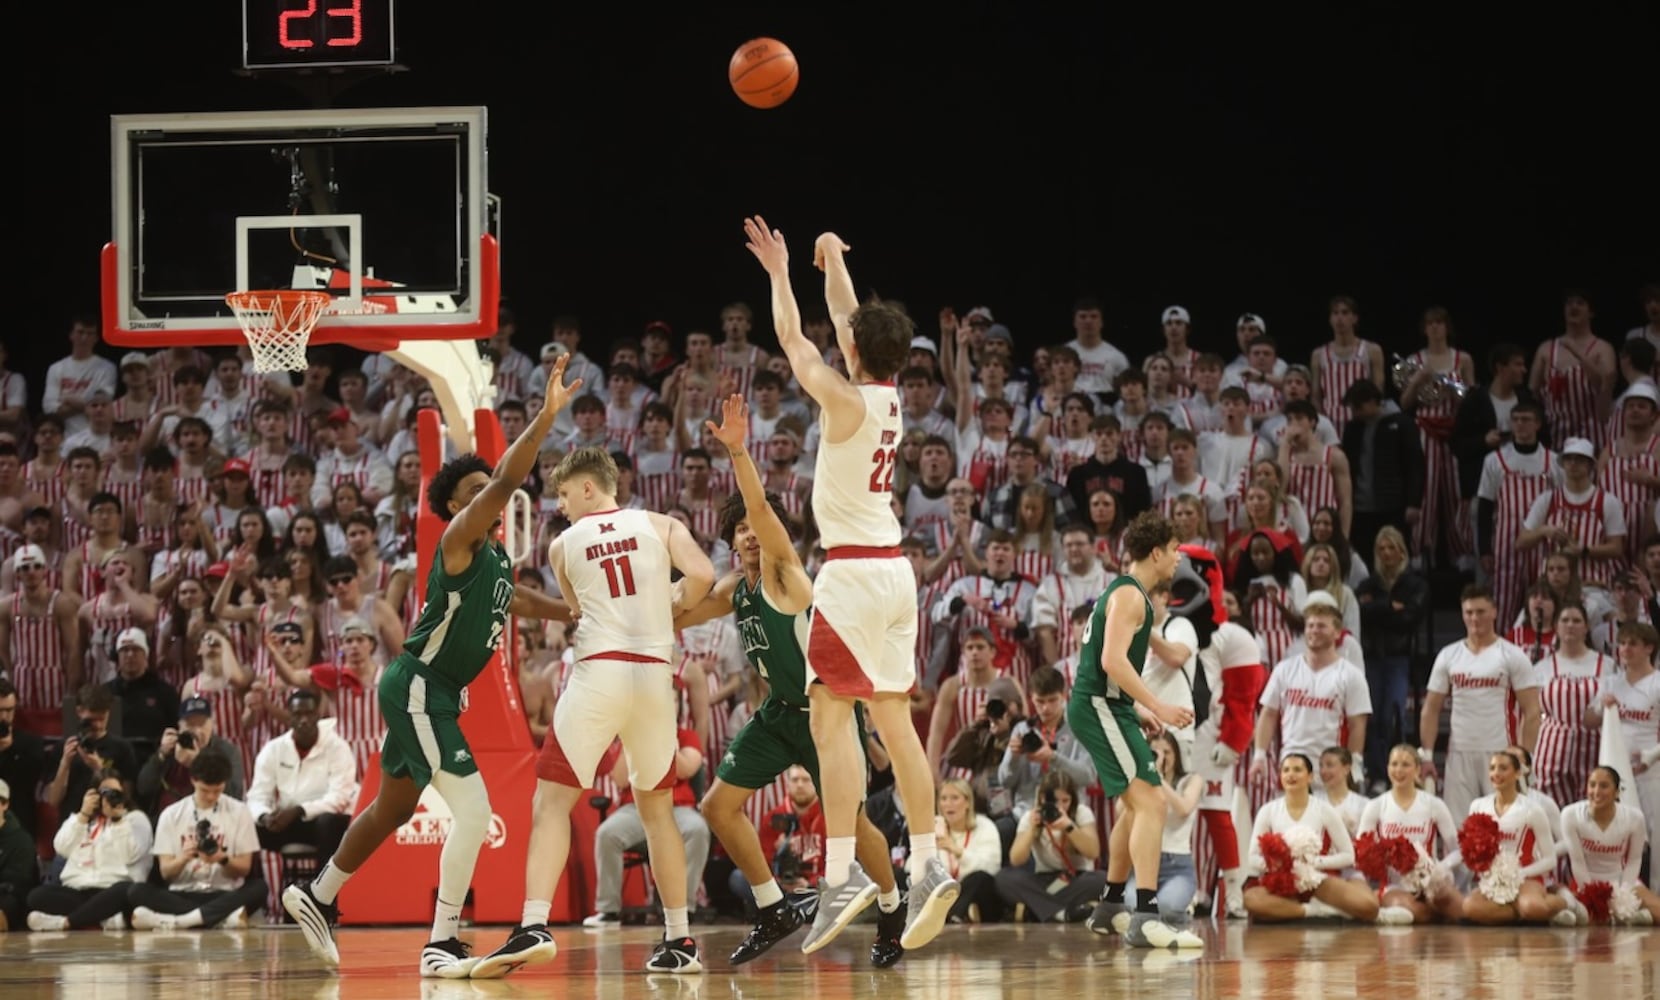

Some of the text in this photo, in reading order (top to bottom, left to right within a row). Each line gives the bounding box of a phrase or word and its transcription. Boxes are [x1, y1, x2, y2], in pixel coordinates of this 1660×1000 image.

[279, 0, 361, 48] 23
[129, 320, 165, 330] SPALDING
[869, 448, 897, 493] 22
[585, 536, 638, 561] ATLASON
[599, 554, 636, 599] 11
[1452, 672, 1503, 689] Miami
[1284, 687, 1338, 710] Miami
[1618, 703, 1653, 721] iami
[1206, 780, 1223, 797] M
[1384, 822, 1426, 836] Miami
[1581, 837, 1624, 854] Miami
